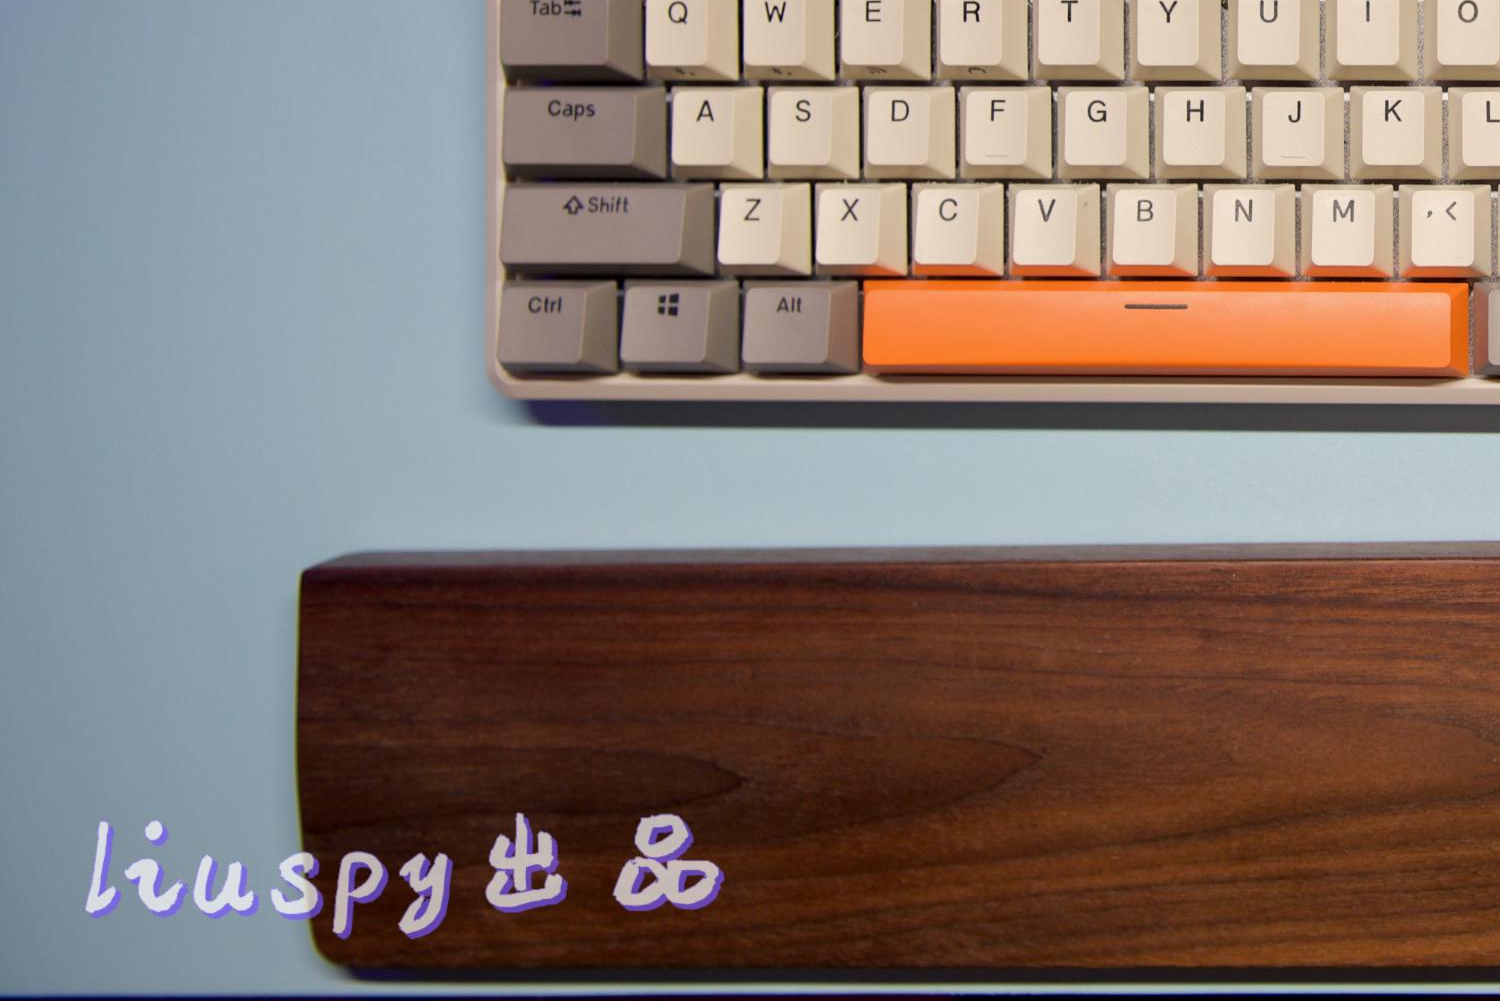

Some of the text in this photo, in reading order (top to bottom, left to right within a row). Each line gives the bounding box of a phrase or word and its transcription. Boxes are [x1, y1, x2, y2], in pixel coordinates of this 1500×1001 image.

[530, 0, 561, 16] Tab
[667, 0, 688, 25] Q
[764, 1, 787, 23] W
[865, 0, 882, 23] E
[962, 0, 981, 23] R
[1060, 0, 1079, 23] T
[1158, 0, 1178, 24] Y
[1259, 0, 1279, 24] U
[1457, 0, 1479, 24] O
[547, 99, 596, 122] Caps
[696, 99, 715, 122] A
[795, 99, 812, 123] S
[890, 99, 910, 122] D
[990, 99, 1006, 122] F
[1087, 99, 1107, 123] G
[1186, 99, 1205, 123] H
[1287, 100, 1302, 124] J
[1384, 99, 1402, 123] K
[1485, 100, 1500, 124] L
[587, 196, 629, 214] Shift
[743, 198, 762, 222] Z
[840, 198, 860, 222] X
[938, 198, 958, 222] C
[1037, 198, 1056, 223] V
[1136, 199, 1154, 223] B
[1234, 198, 1254, 223] N
[1332, 199, 1355, 223] M
[527, 296, 563, 314] Ctrl
[776, 296, 802, 314] Alt
